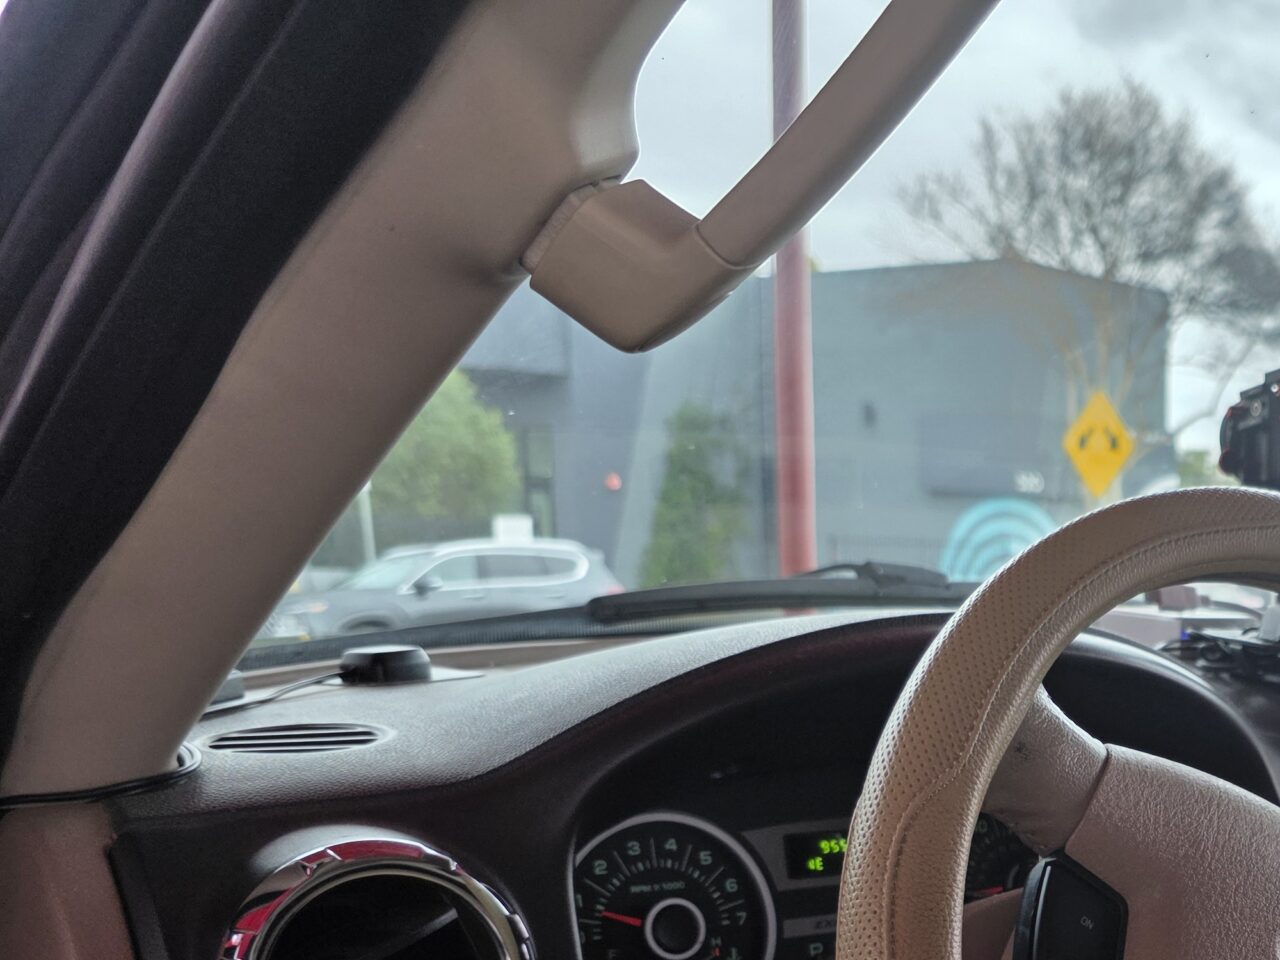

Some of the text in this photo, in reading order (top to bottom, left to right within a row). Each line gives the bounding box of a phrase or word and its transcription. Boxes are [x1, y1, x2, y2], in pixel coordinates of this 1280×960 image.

[627, 841, 641, 856] 3
[664, 837, 678, 851] 4
[698, 850, 713, 865] 5
[593, 859, 608, 876] 2
[725, 878, 739, 893] 6
[735, 911, 747, 925] 7
[1080, 915, 1095, 931] ON
[711, 938, 722, 948] H
[809, 942, 824, 957] P
